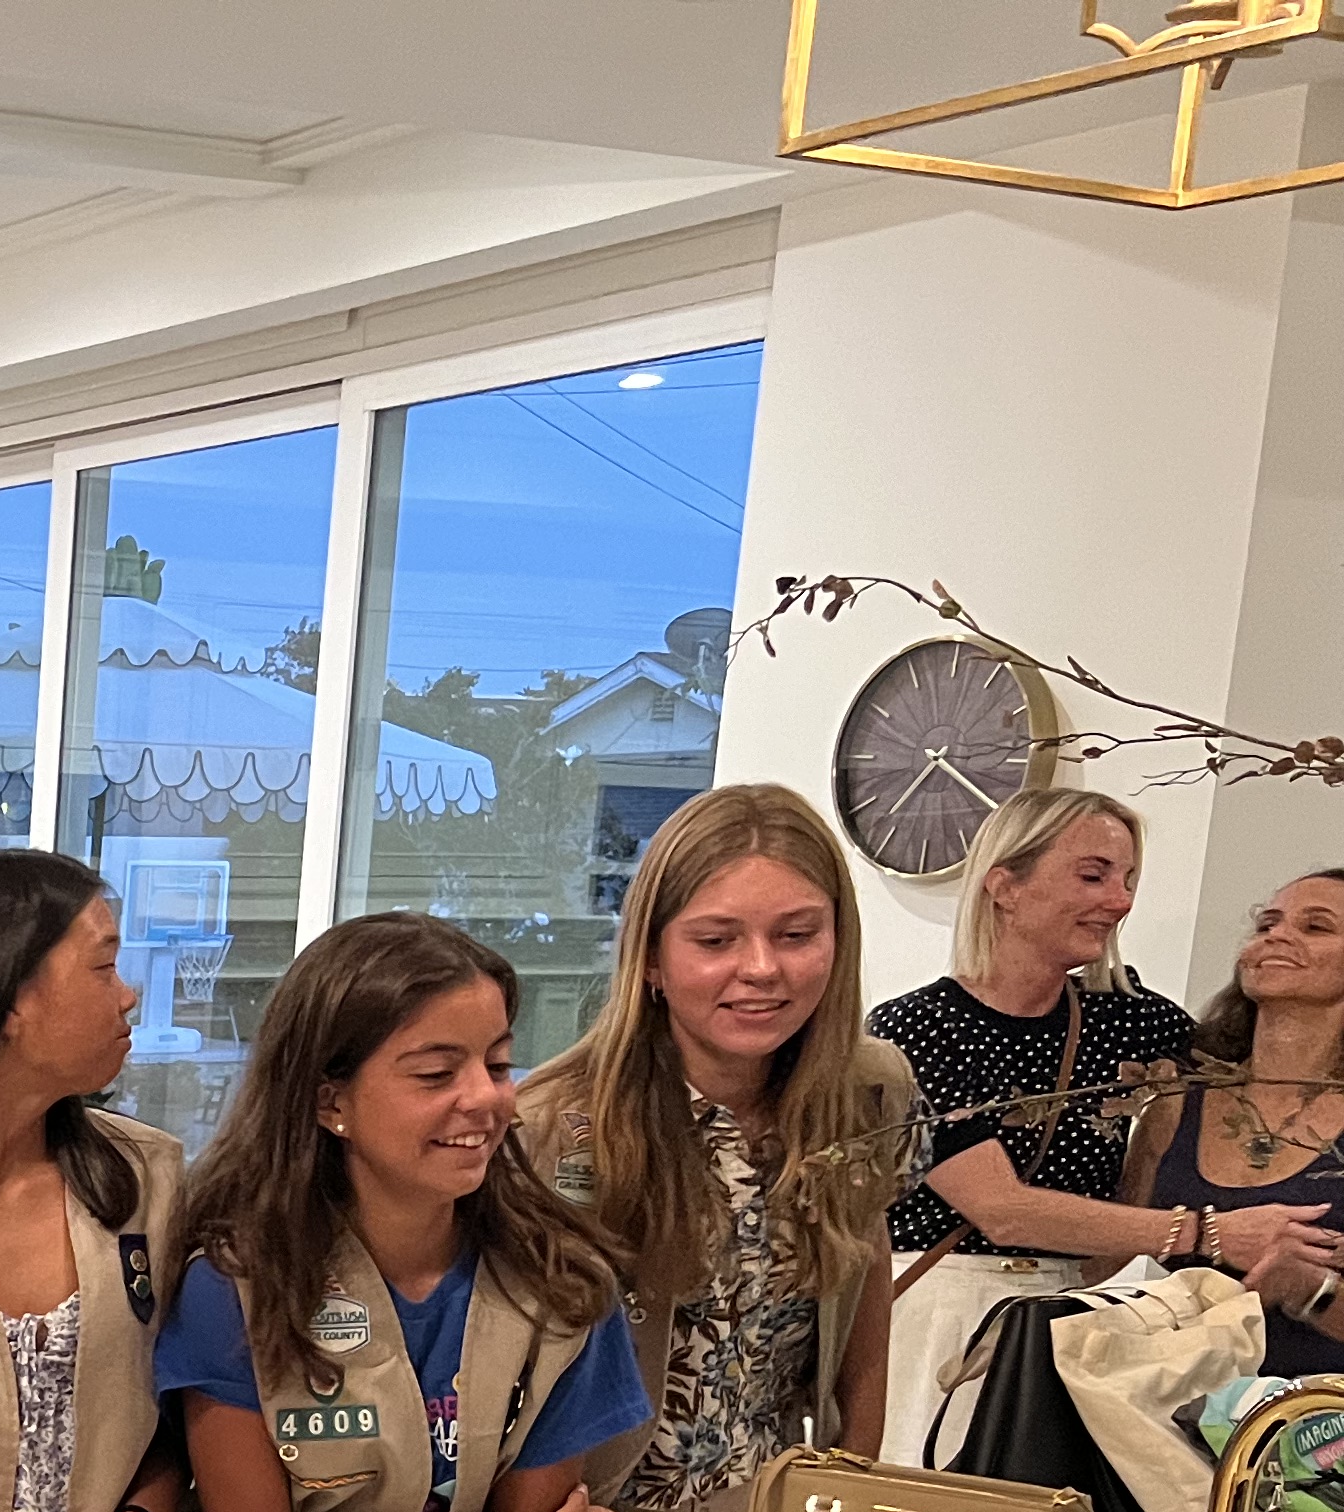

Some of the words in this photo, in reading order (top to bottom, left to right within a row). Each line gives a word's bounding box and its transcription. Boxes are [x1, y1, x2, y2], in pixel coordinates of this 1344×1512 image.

[344, 1311, 366, 1322] USA
[323, 1330, 364, 1341] COUNTY
[281, 1408, 374, 1437] 4609
